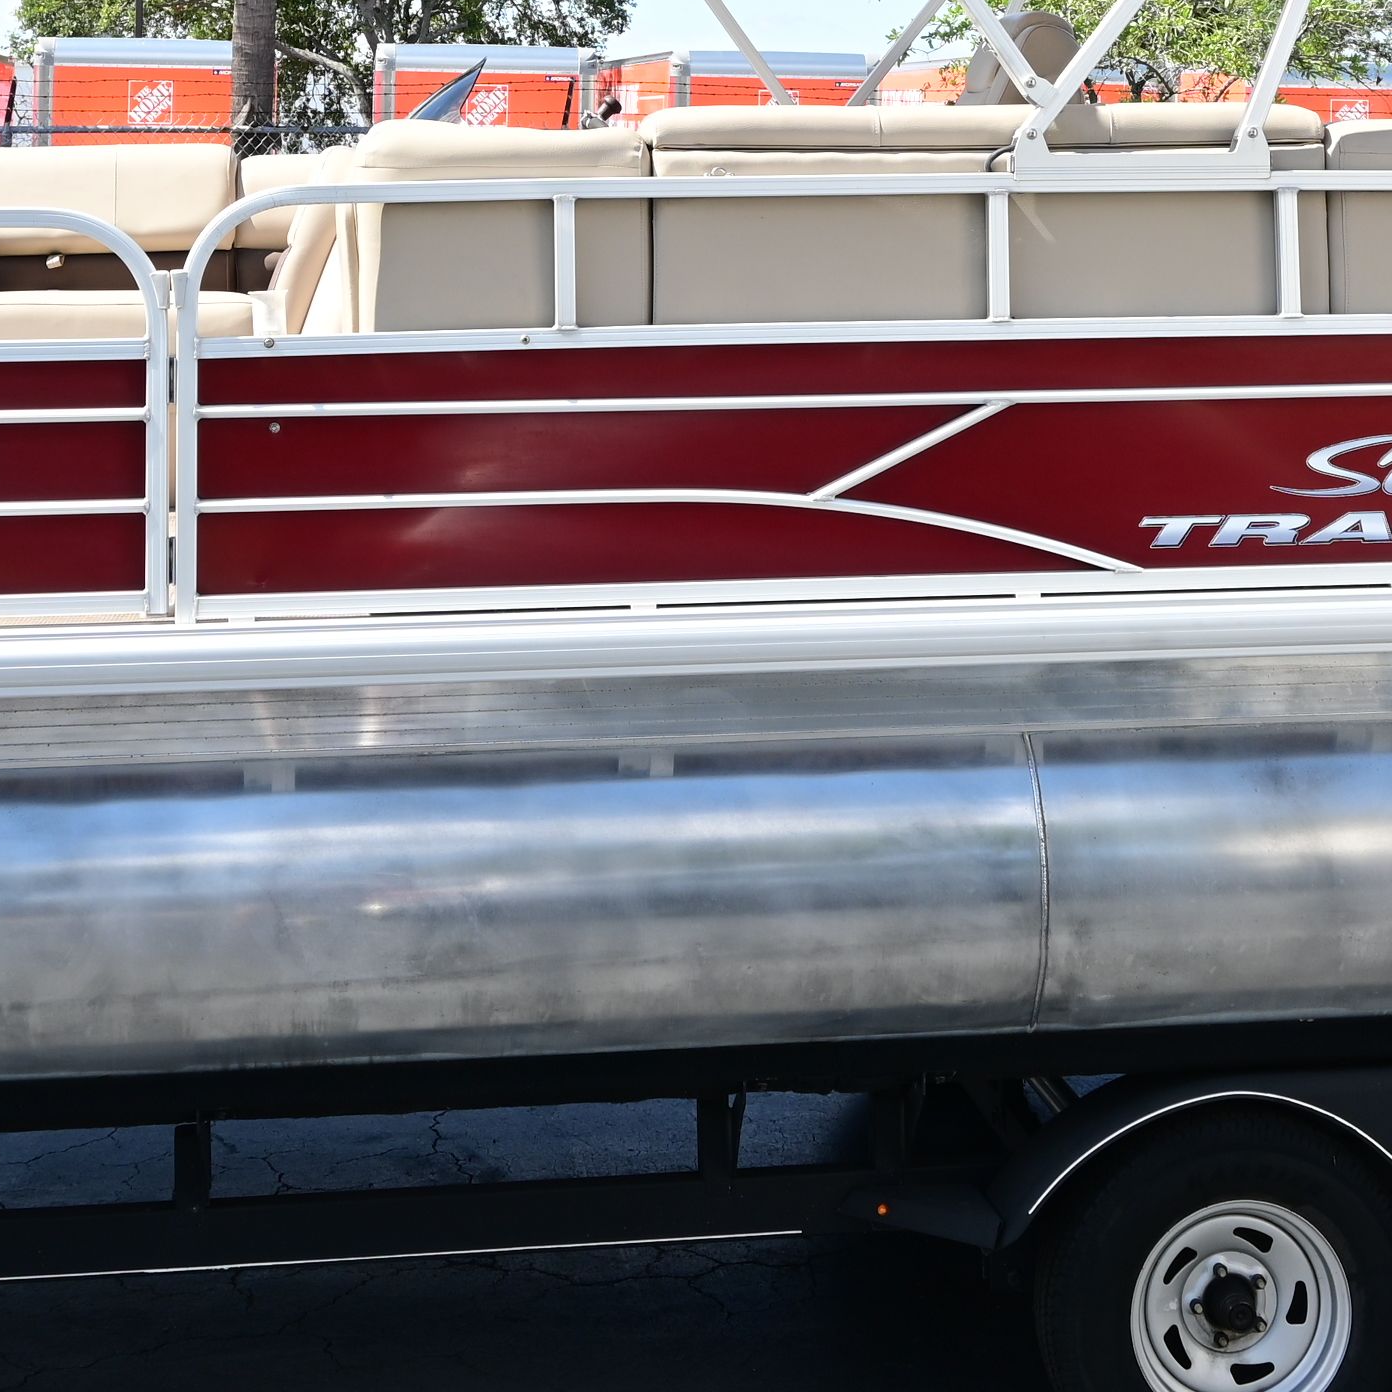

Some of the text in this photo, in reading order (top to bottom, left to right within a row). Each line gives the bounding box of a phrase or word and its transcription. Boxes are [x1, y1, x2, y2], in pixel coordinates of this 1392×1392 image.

[129, 81, 172, 123] HOME
[133, 85, 152, 102] THE
[467, 85, 507, 125] HOME
